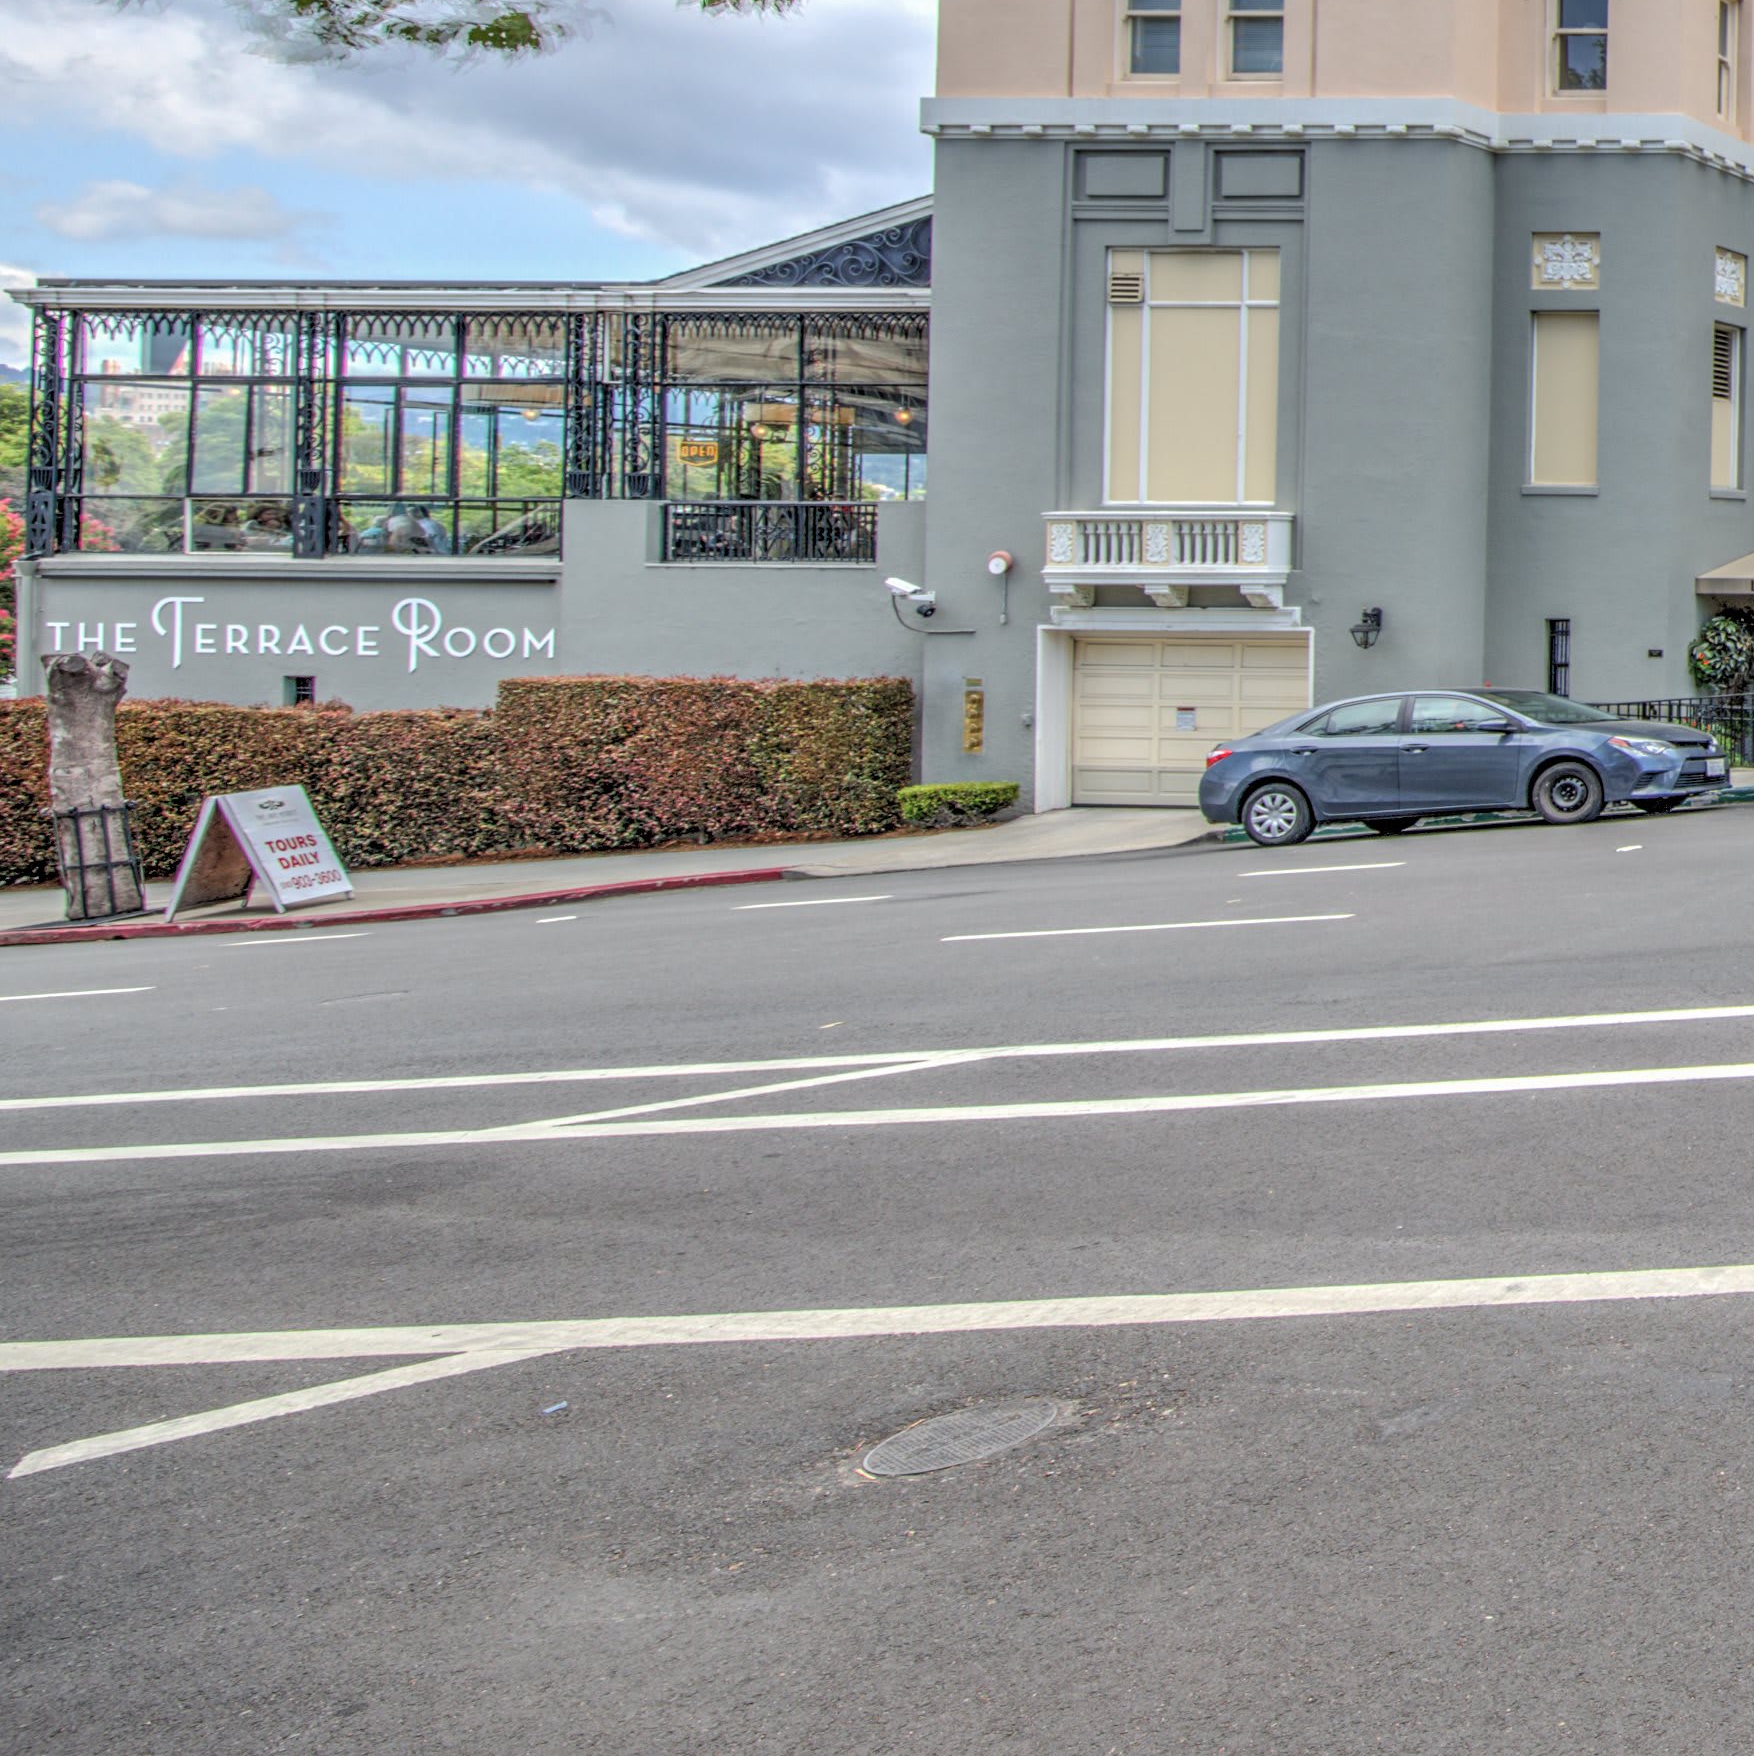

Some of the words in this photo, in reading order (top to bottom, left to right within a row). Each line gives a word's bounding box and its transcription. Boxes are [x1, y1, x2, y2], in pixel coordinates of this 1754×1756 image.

[681, 445, 714, 457] OPEN
[46, 621, 138, 653] THE
[151, 596, 381, 669] TERRACE
[391, 597, 556, 673] ROOM
[264, 834, 318, 854] TOURS
[278, 851, 320, 870] DAILY
